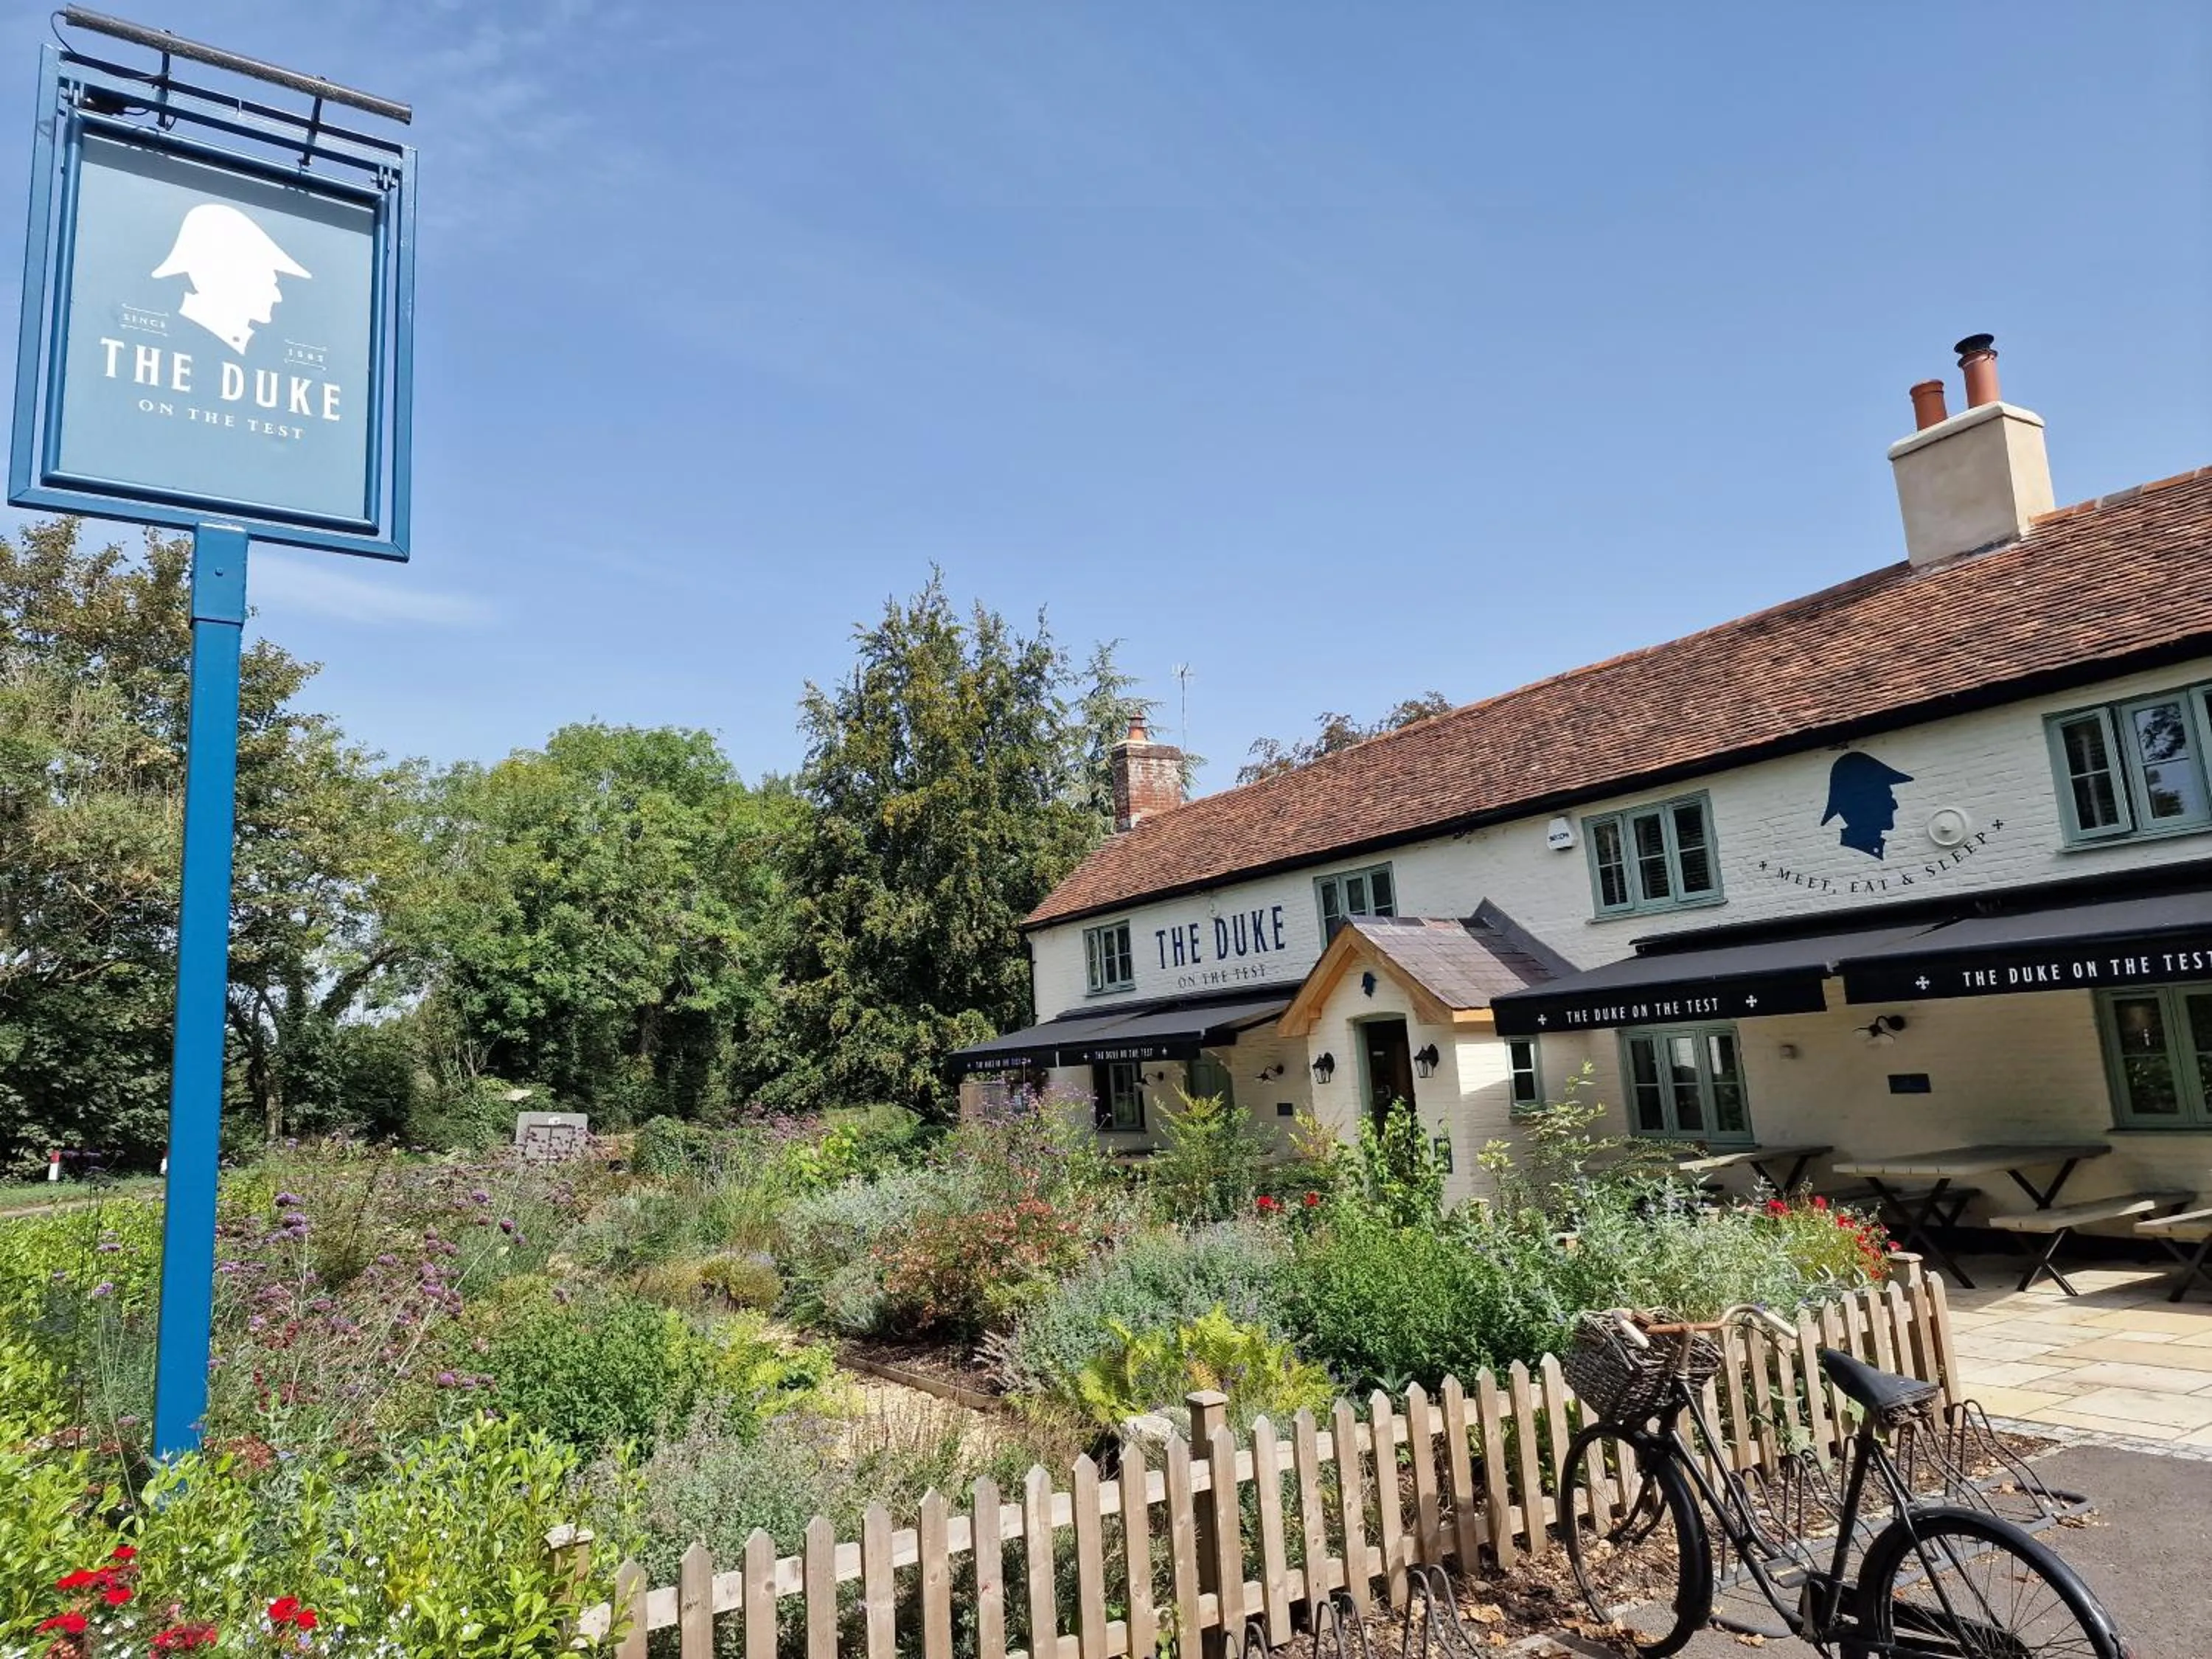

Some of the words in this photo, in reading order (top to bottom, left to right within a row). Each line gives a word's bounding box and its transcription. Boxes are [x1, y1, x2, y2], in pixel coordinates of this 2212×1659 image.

[100, 337, 193, 393] THE
[220, 361, 341, 421] DUKE
[139, 399, 174, 417] ON
[188, 408, 234, 428] THE
[248, 419, 305, 439] TEST
[1776, 866, 1837, 894] MEET,
[1851, 879, 1888, 893] EAT
[1902, 873, 1915, 886] &
[1925, 832, 1986, 877] SLEEP
[1155, 923, 1202, 970] THE
[1212, 905, 1286, 960] DUKE
[1178, 976, 1195, 989] ON
[1203, 970, 1228, 984] THE
[1236, 964, 1266, 980] TEST
[1963, 970, 1997, 987] THE
[2008, 964, 2061, 984] DUKE
[2073, 961, 2098, 979] ON
[2110, 956, 2150, 975] THE
[1566, 1009, 1588, 1023] THE
[1594, 1006, 1626, 1021] DUKE
[1632, 1004, 1648, 1018] ON
[1655, 1001, 1679, 1015] THE
[1686, 998, 1718, 1013] TEST
